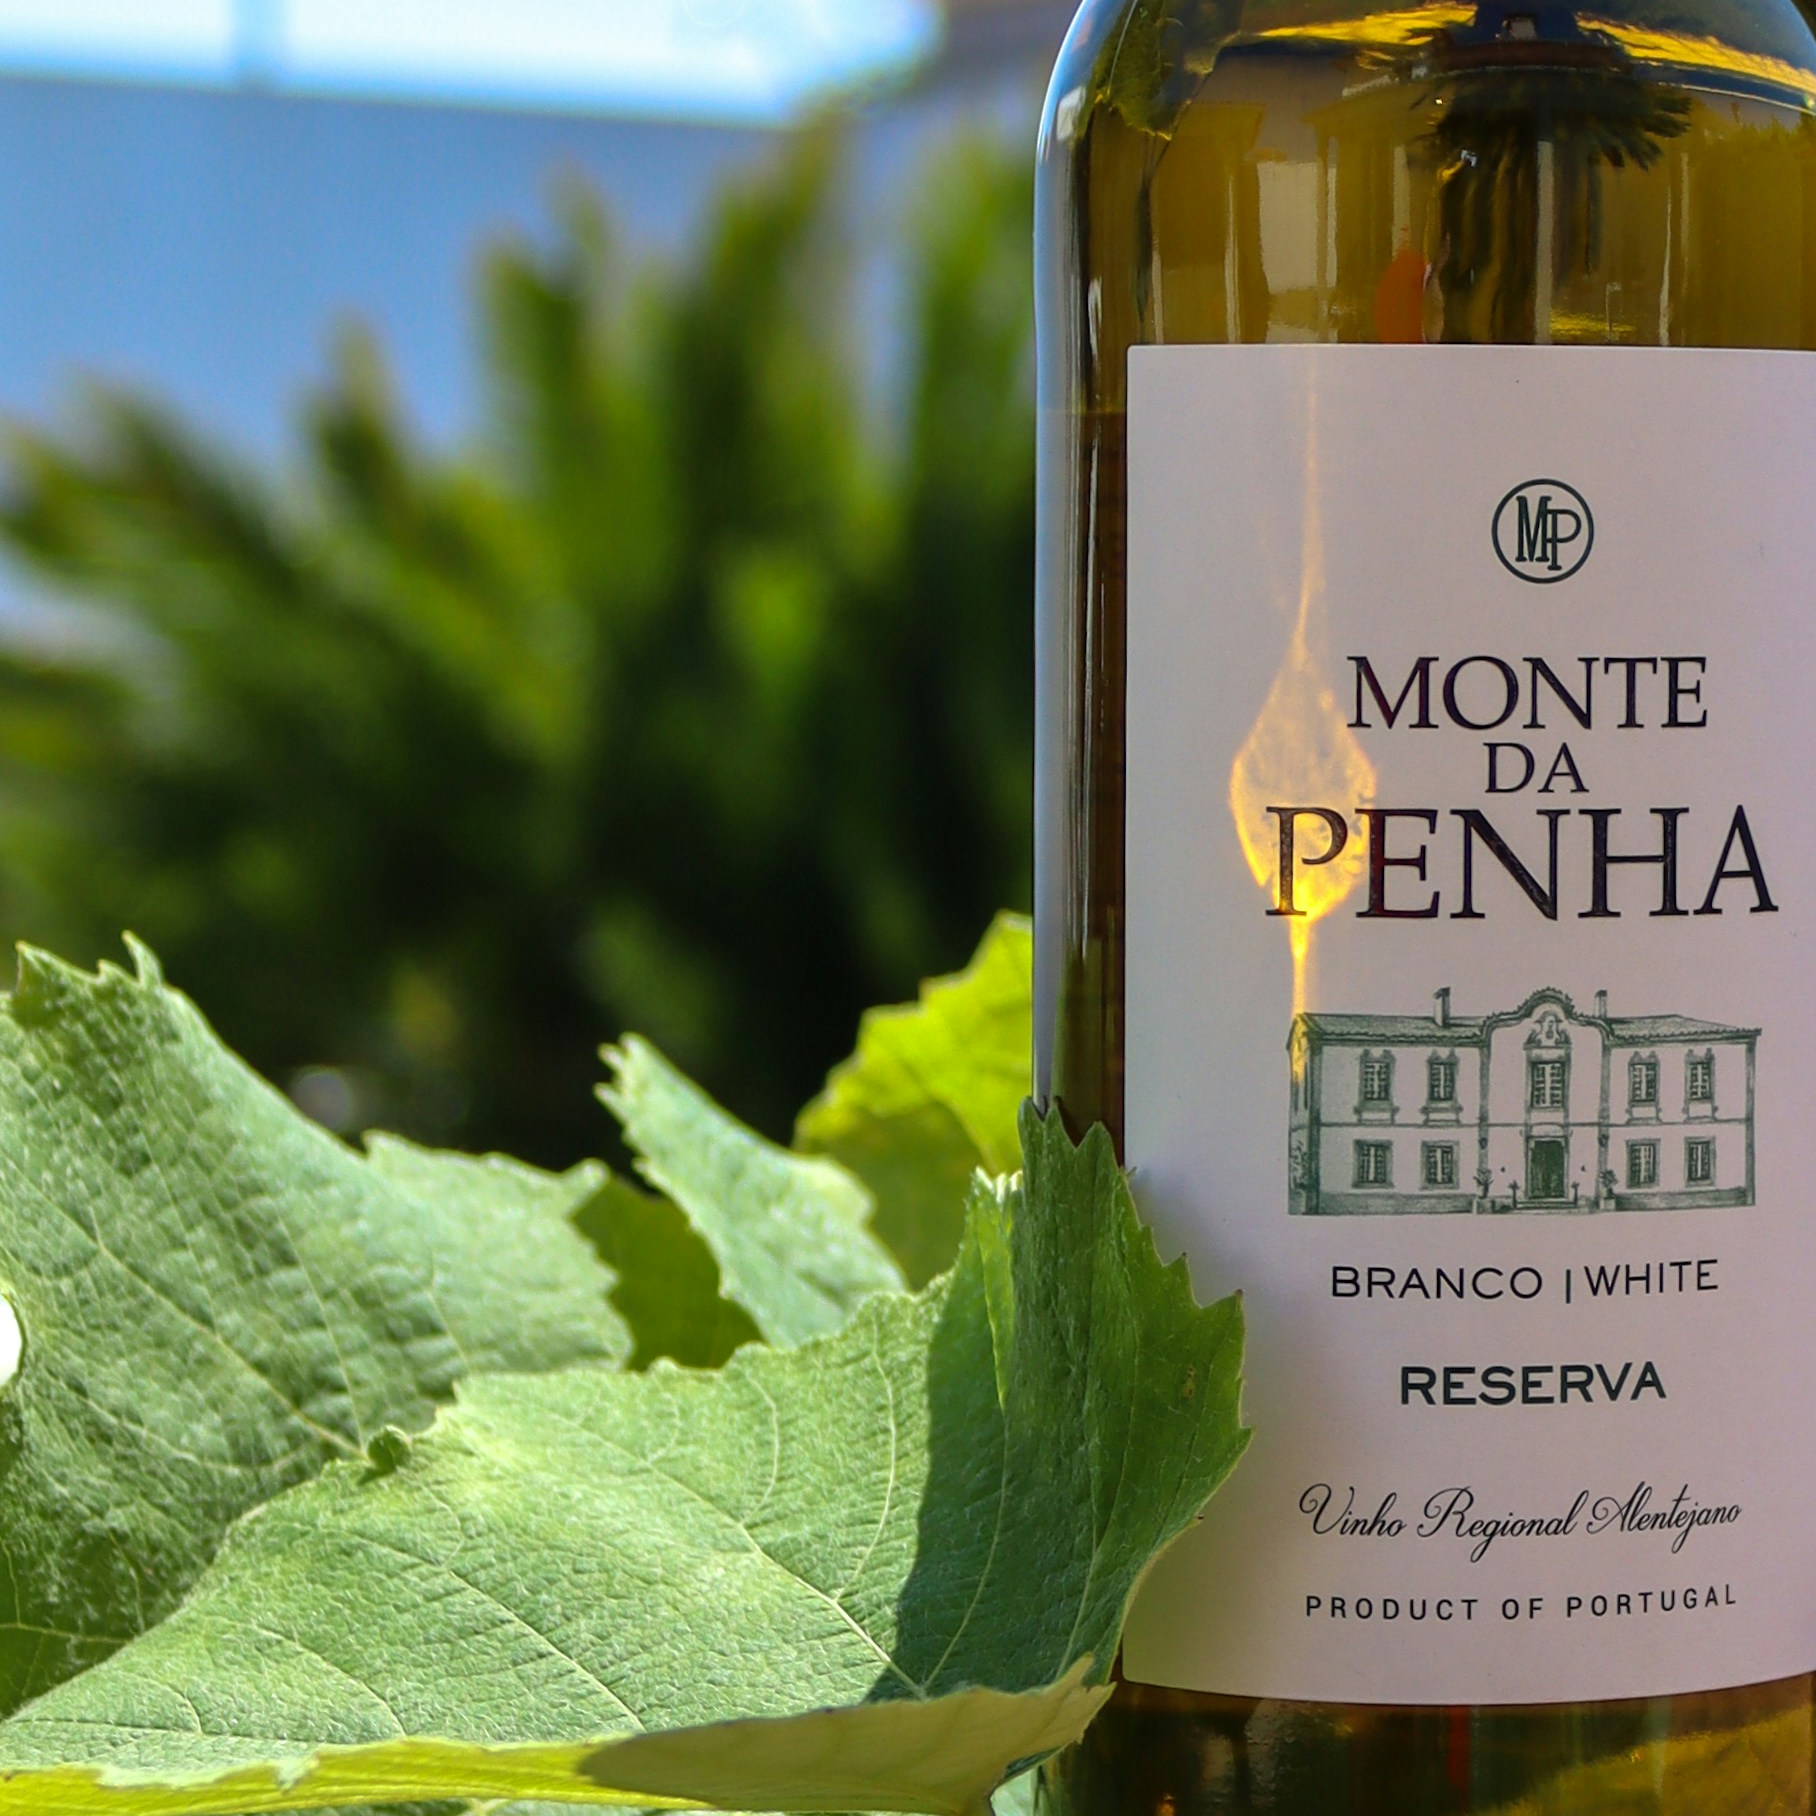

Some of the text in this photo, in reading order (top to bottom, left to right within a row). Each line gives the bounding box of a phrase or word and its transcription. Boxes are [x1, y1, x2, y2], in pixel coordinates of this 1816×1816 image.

[1346, 655, 1708, 731] MONTE
[1482, 742, 1590, 794] DA
[1265, 804, 1779, 922] PENHA
[1331, 1265, 1543, 1300] BRANCO
[1583, 1258, 1720, 1297] WHITE
[1400, 1361, 1667, 1406] RESERVA
[1298, 1480, 1743, 1563] Vinho Regional Alentejano
[1306, 1582, 1737, 1621] PRODUCT OF PORTUGAL
